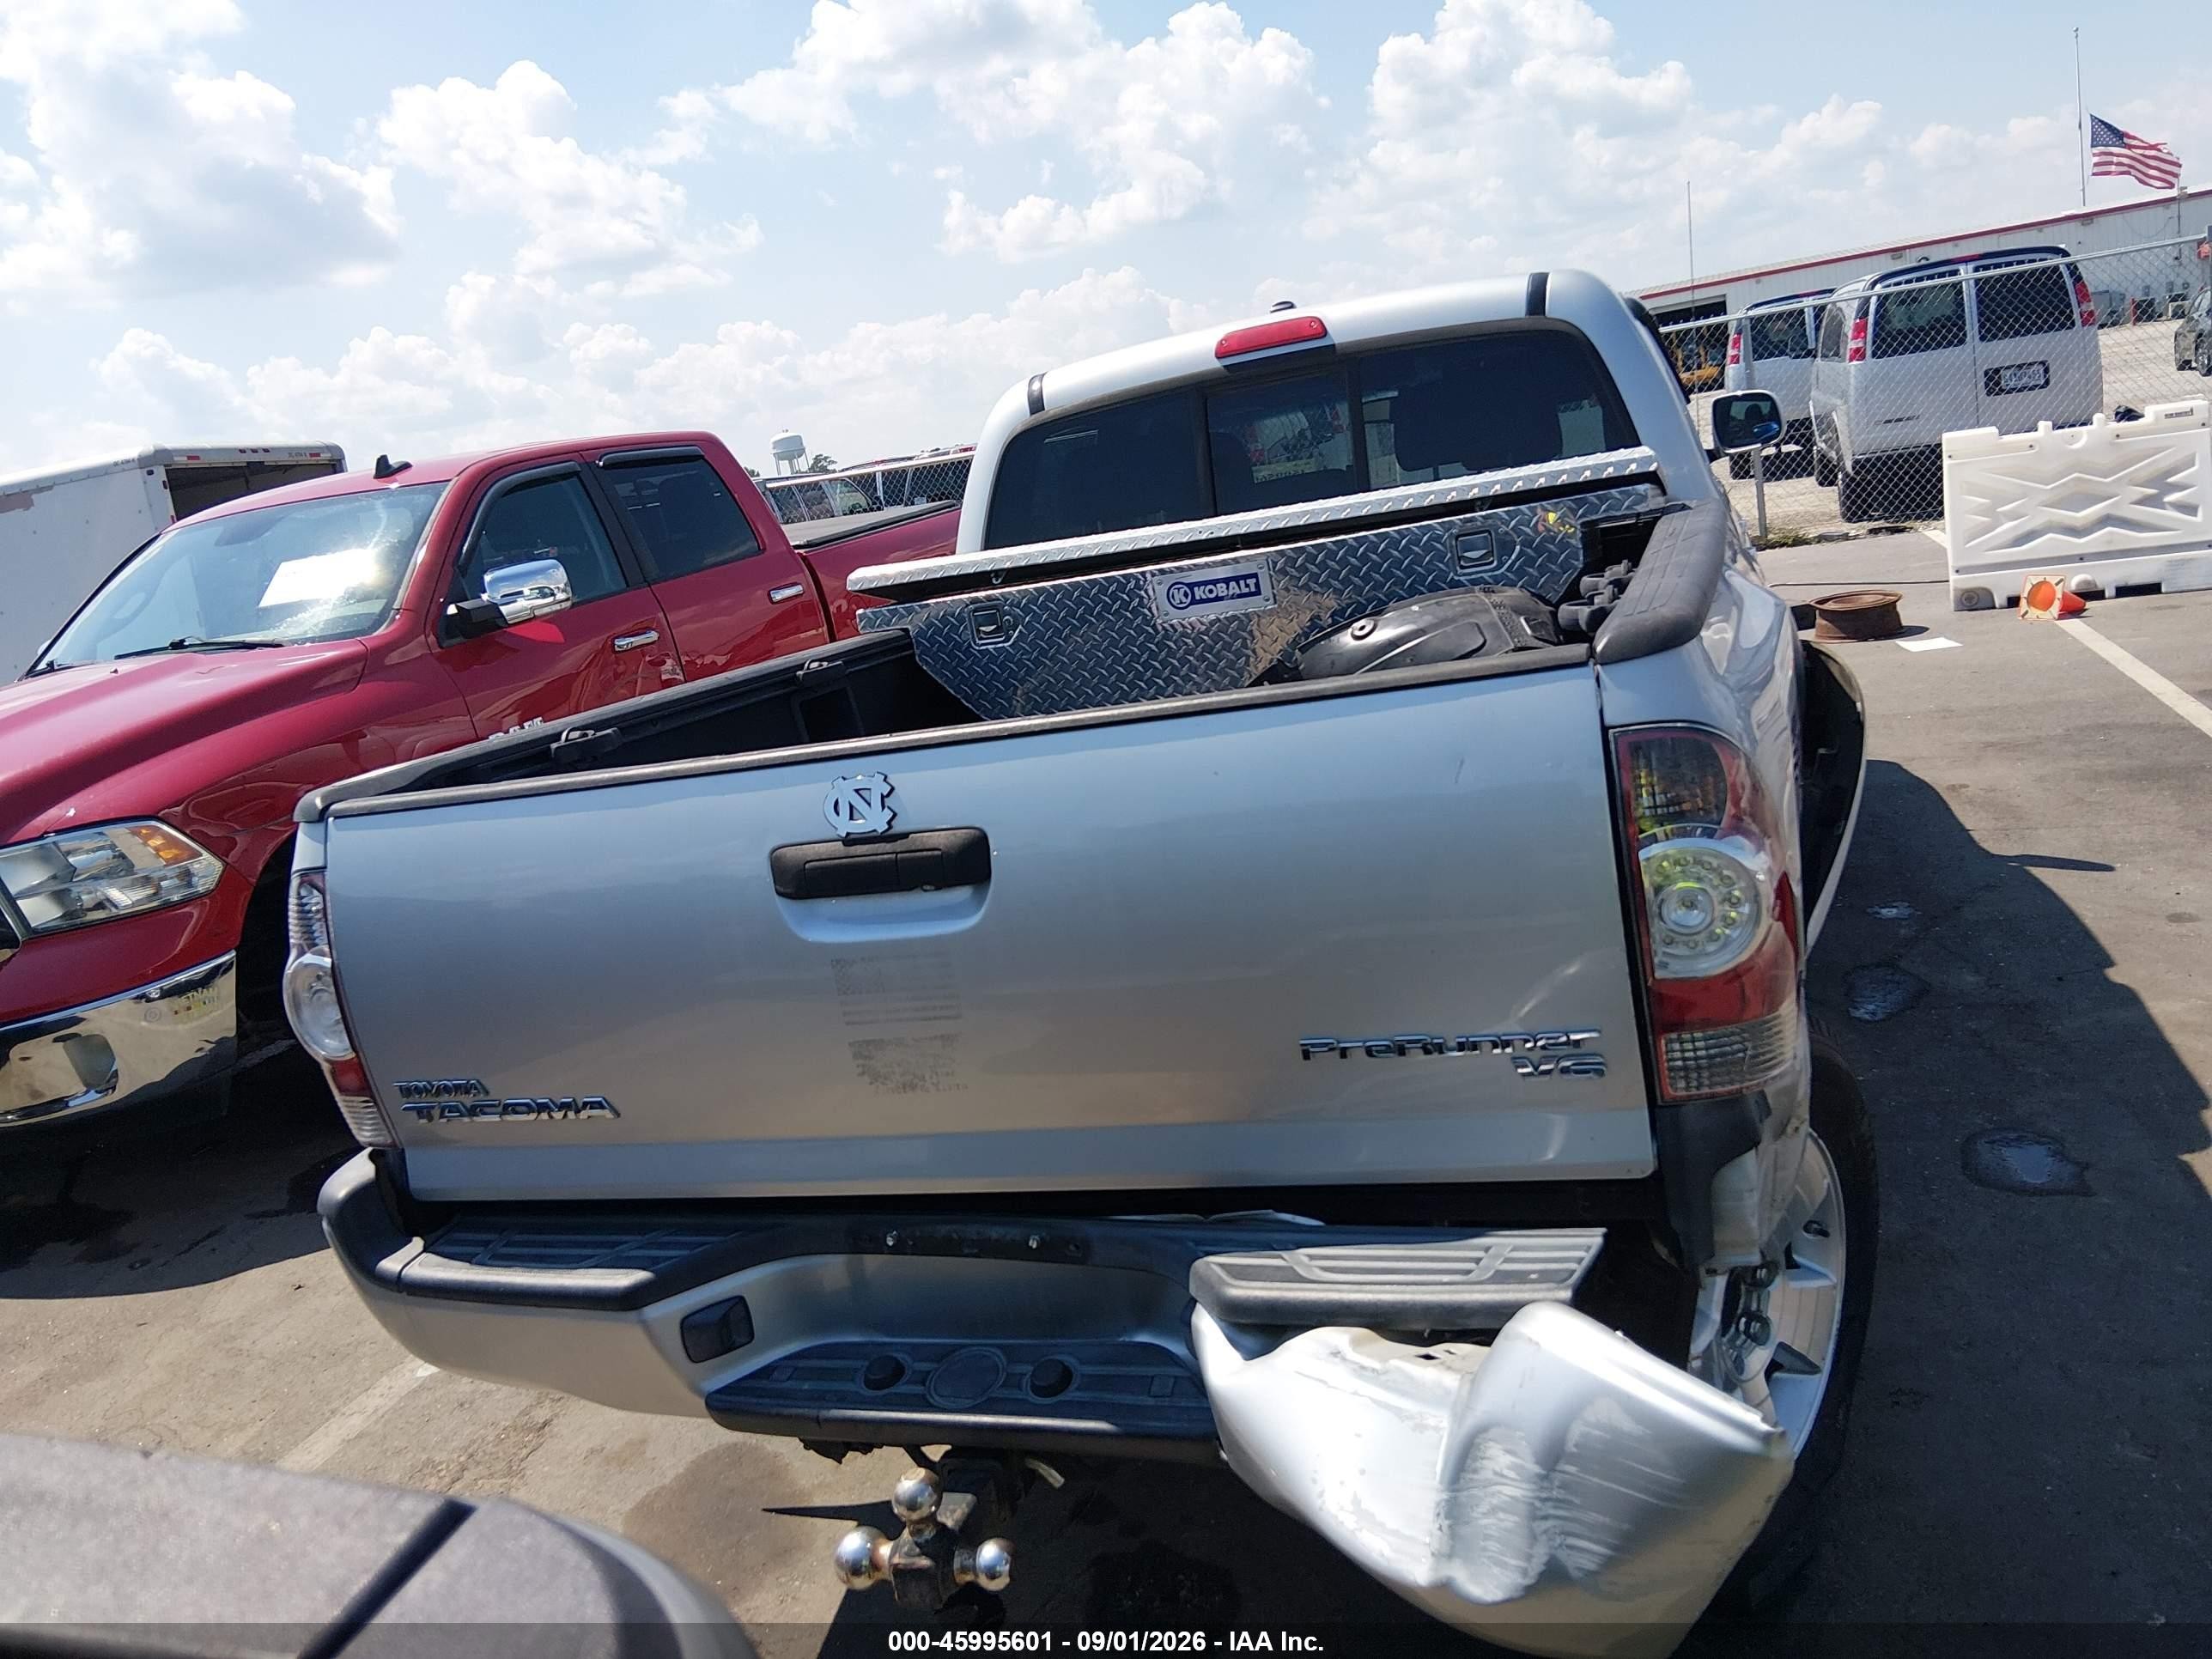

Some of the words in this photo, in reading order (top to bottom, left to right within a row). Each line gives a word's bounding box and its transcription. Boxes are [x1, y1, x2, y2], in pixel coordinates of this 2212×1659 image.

[1194, 578, 1257, 600] KOBALT
[1298, 1029, 1601, 1060] PreRunner
[1511, 1054, 1607, 1079] V6
[392, 1079, 489, 1099] TOYOTA
[400, 1097, 621, 1122] TACOMA
